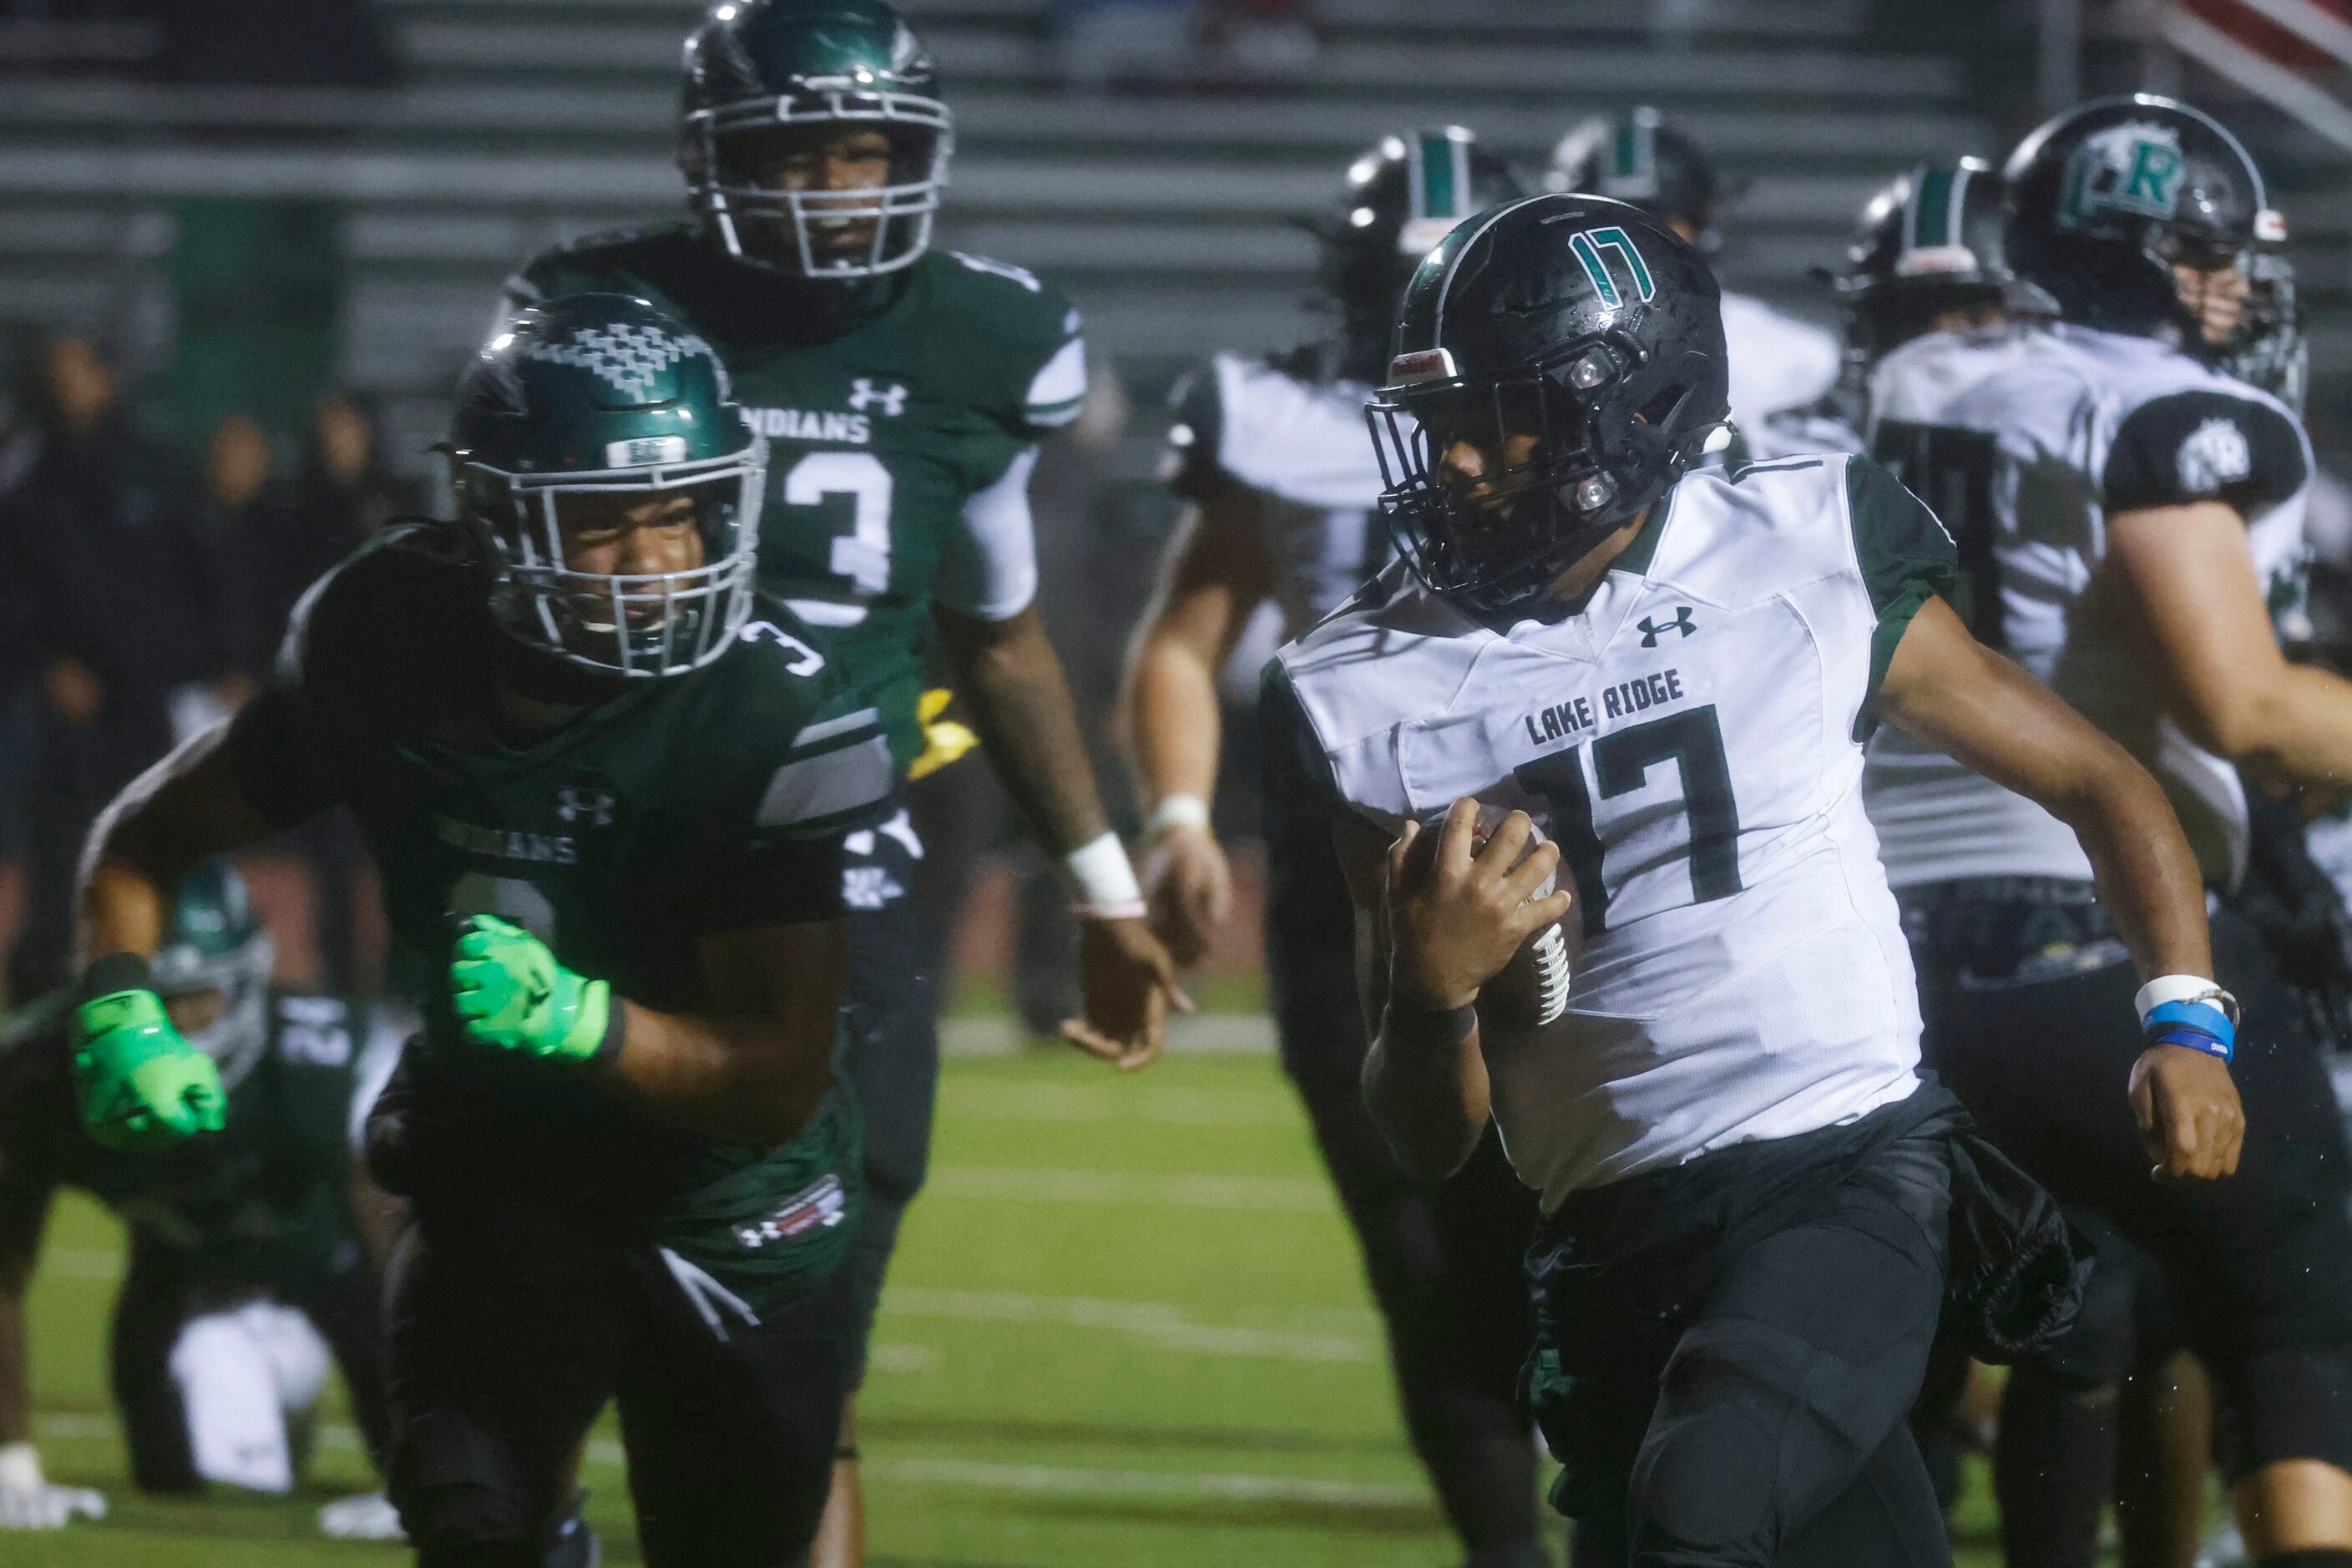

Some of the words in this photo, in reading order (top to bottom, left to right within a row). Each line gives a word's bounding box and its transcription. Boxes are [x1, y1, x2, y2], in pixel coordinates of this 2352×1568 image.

[1567, 225, 1657, 312] 17
[740, 406, 870, 444] NDIANS
[738, 620, 826, 676] 3
[1525, 696, 1594, 746] LAKE
[1603, 669, 1683, 719] RIDGE
[1513, 703, 1744, 940] 17
